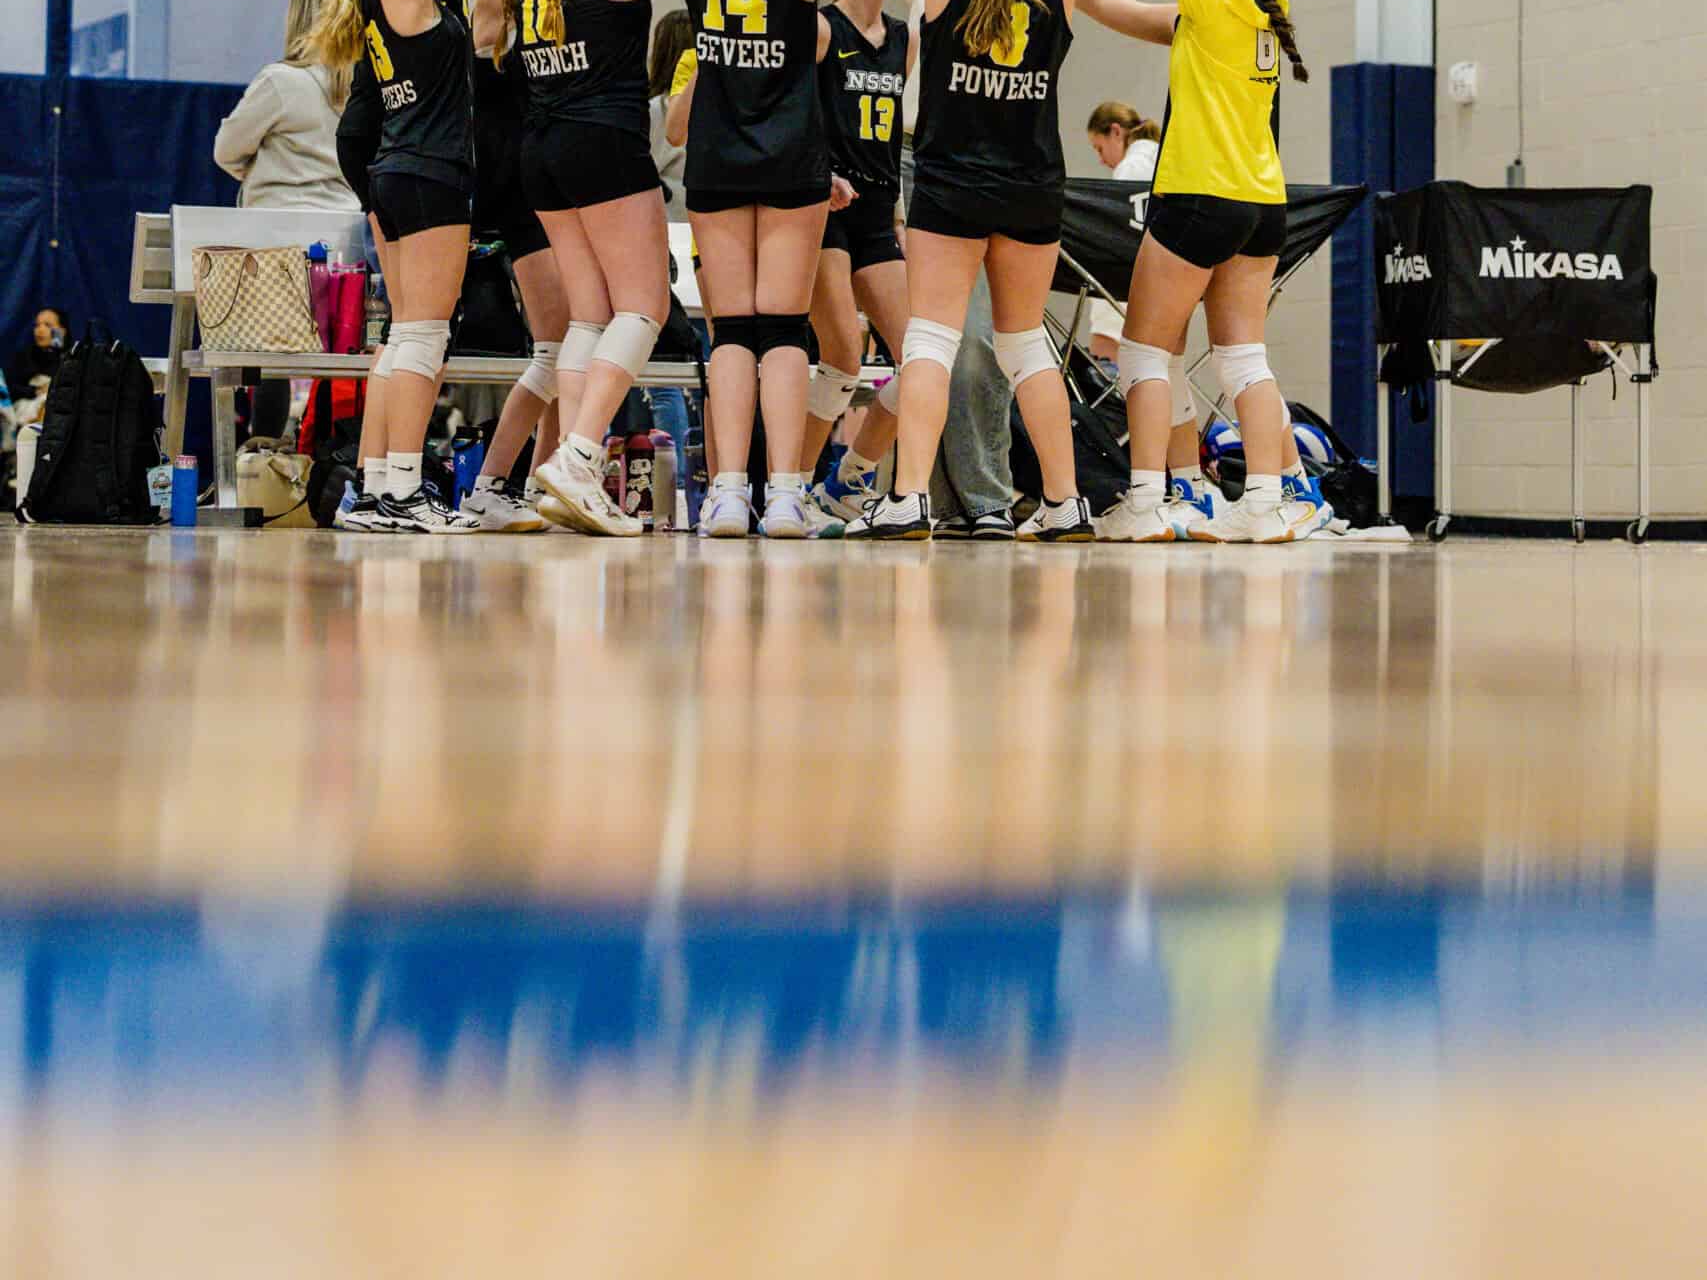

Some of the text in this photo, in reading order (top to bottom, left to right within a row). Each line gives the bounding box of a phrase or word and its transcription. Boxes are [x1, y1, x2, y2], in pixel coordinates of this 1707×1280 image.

[696, 32, 786, 69] SEVERS
[948, 62, 1049, 100] POWERS
[859, 95, 895, 142] 13
